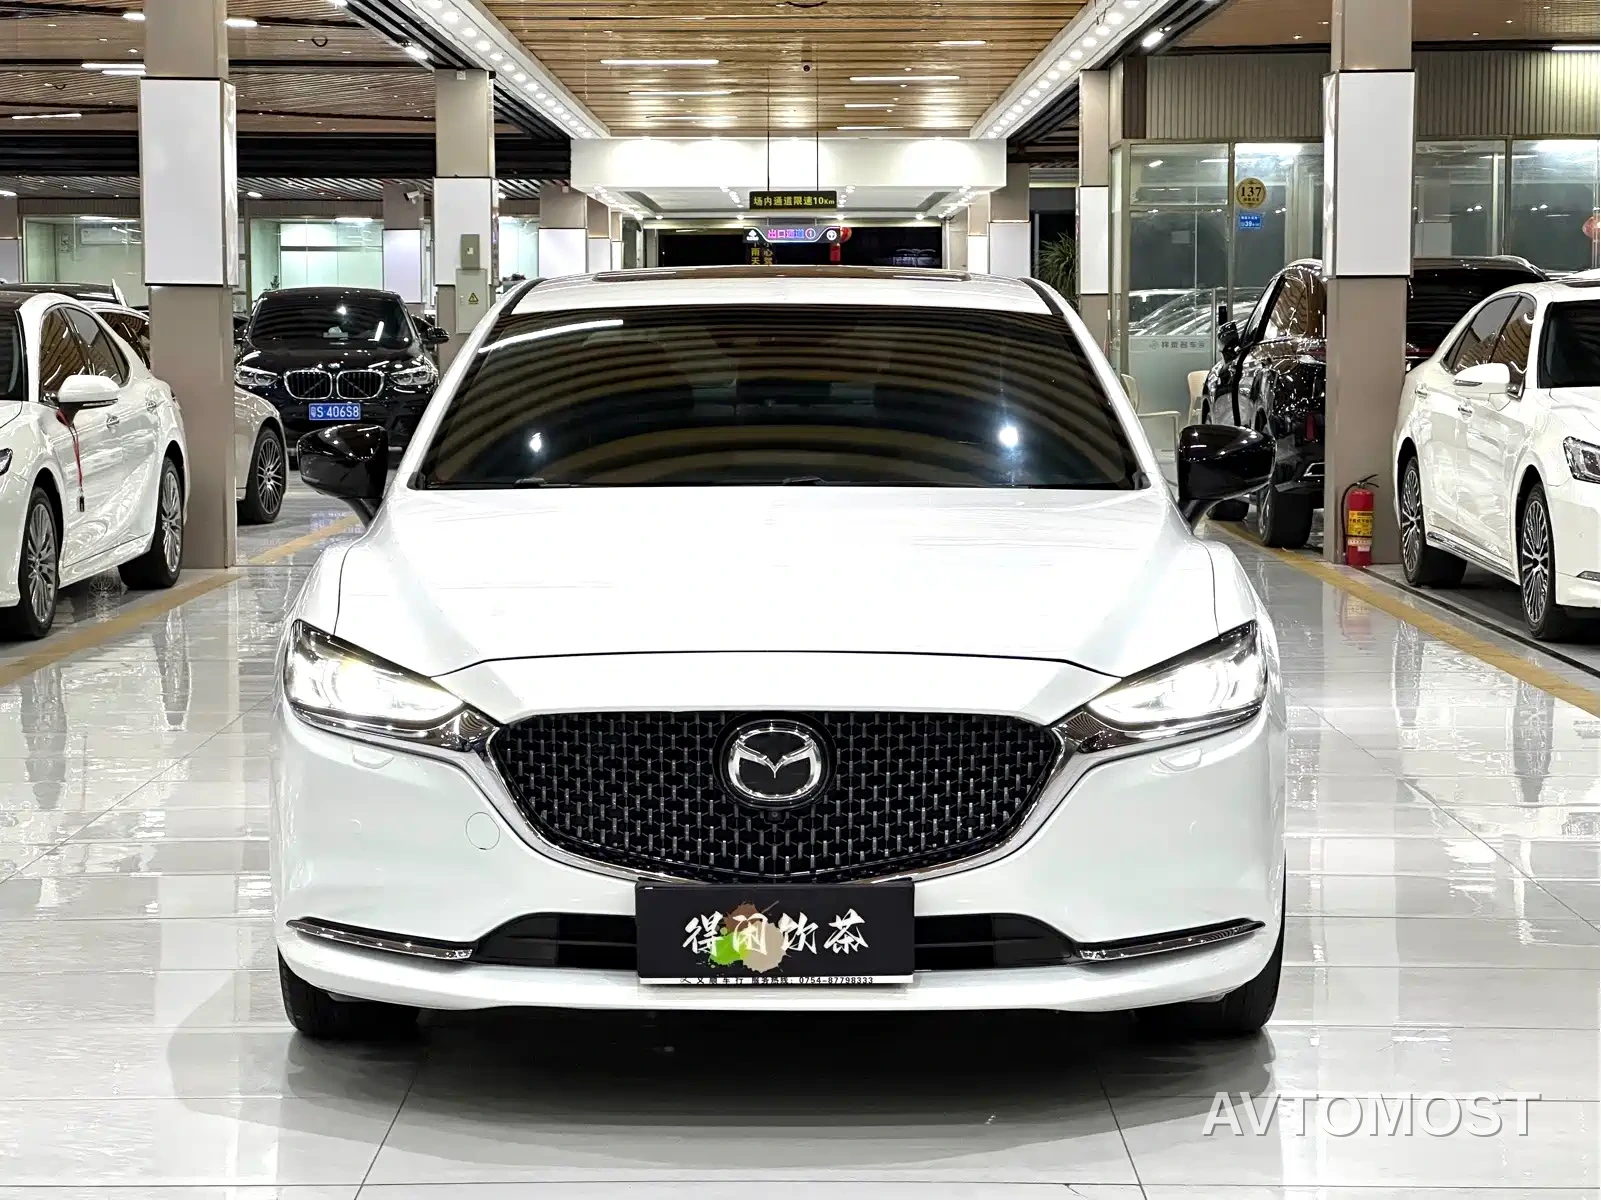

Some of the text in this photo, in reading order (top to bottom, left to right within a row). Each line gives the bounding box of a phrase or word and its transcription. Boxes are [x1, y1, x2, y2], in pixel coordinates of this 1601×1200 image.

[1241, 187, 1262, 197] 137
[682, 908, 869, 956] 得闲饮茶
[799, 976, 874, 984] 0754-87798333
